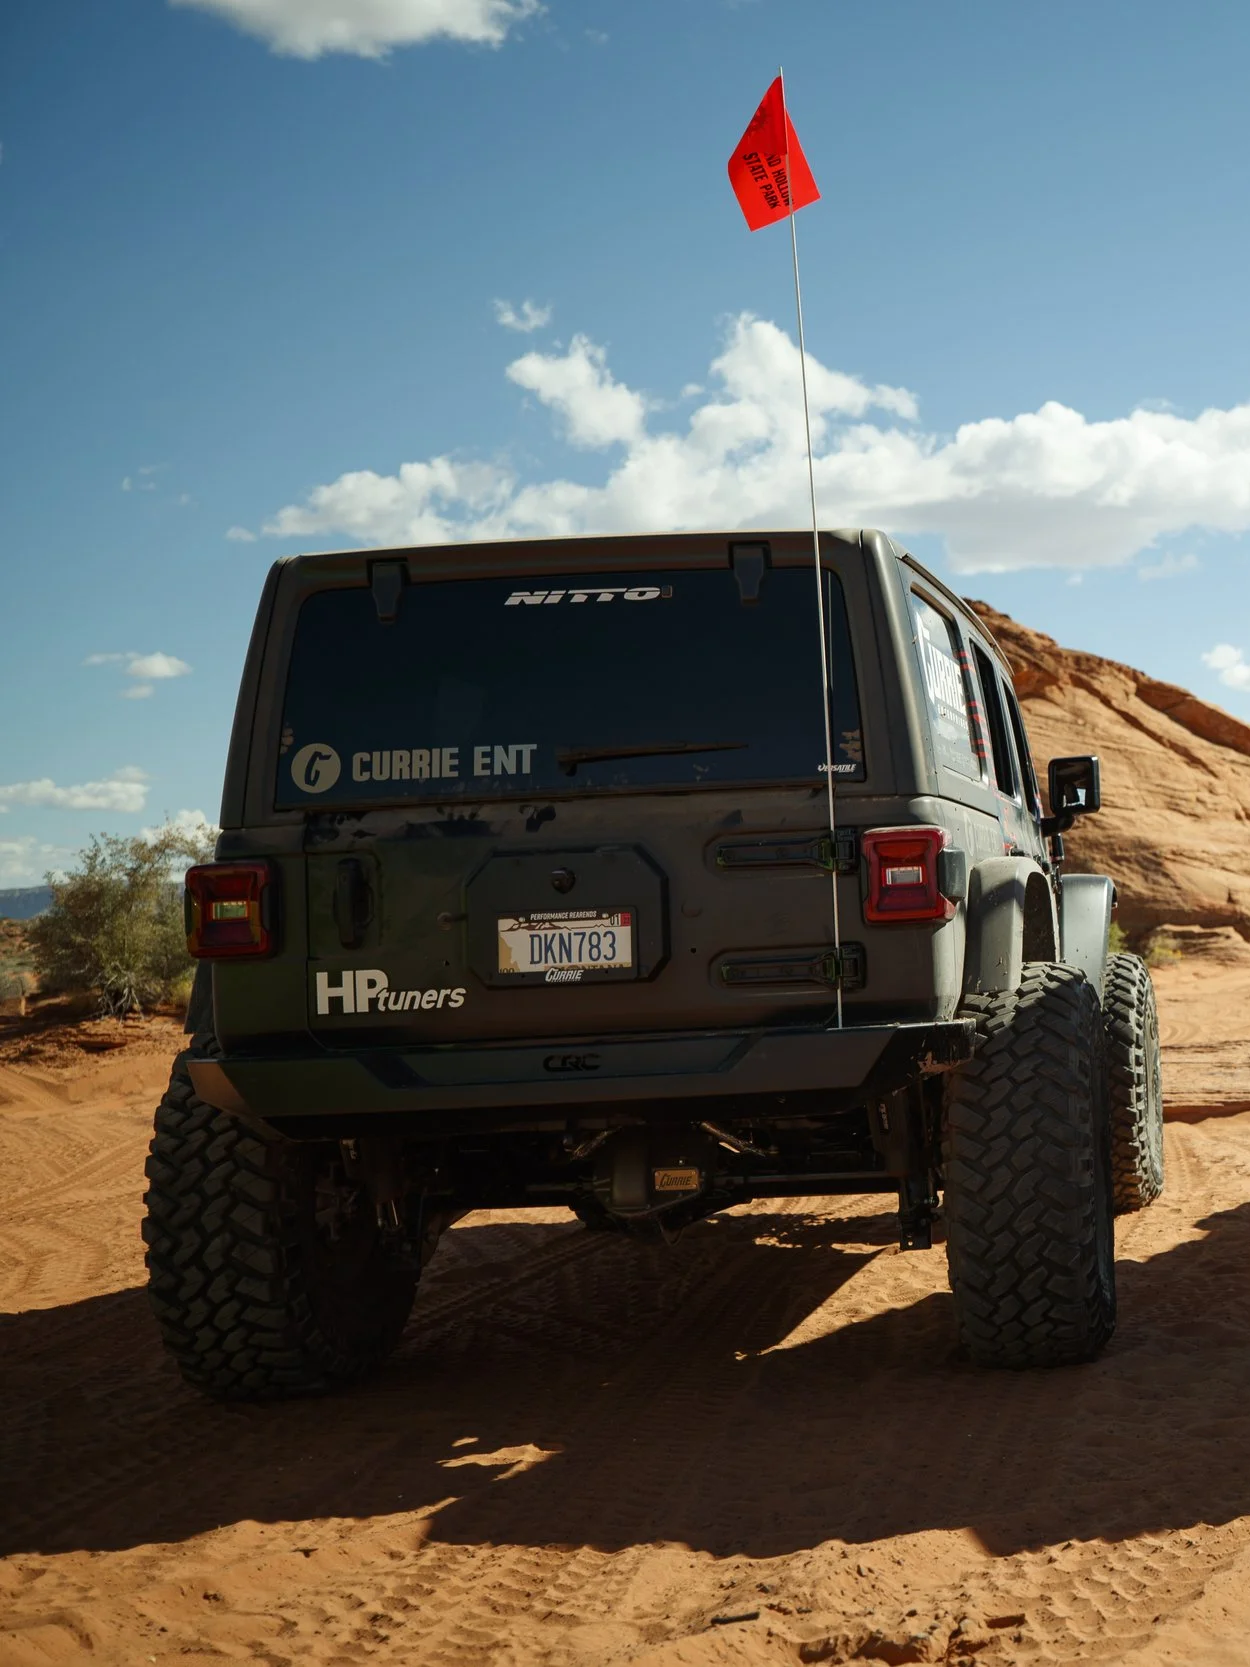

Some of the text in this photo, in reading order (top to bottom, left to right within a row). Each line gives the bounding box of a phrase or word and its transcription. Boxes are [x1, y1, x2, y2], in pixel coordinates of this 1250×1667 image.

[743, 152, 781, 210] STATE PARK
[352, 744, 537, 782] CURRIE ENT
[530, 910, 597, 920] PERFORMANCE REARENDS
[529, 930, 616, 965] DKN783
[545, 968, 584, 982] CURRIE
[660, 1173, 693, 1187] CURRIE
